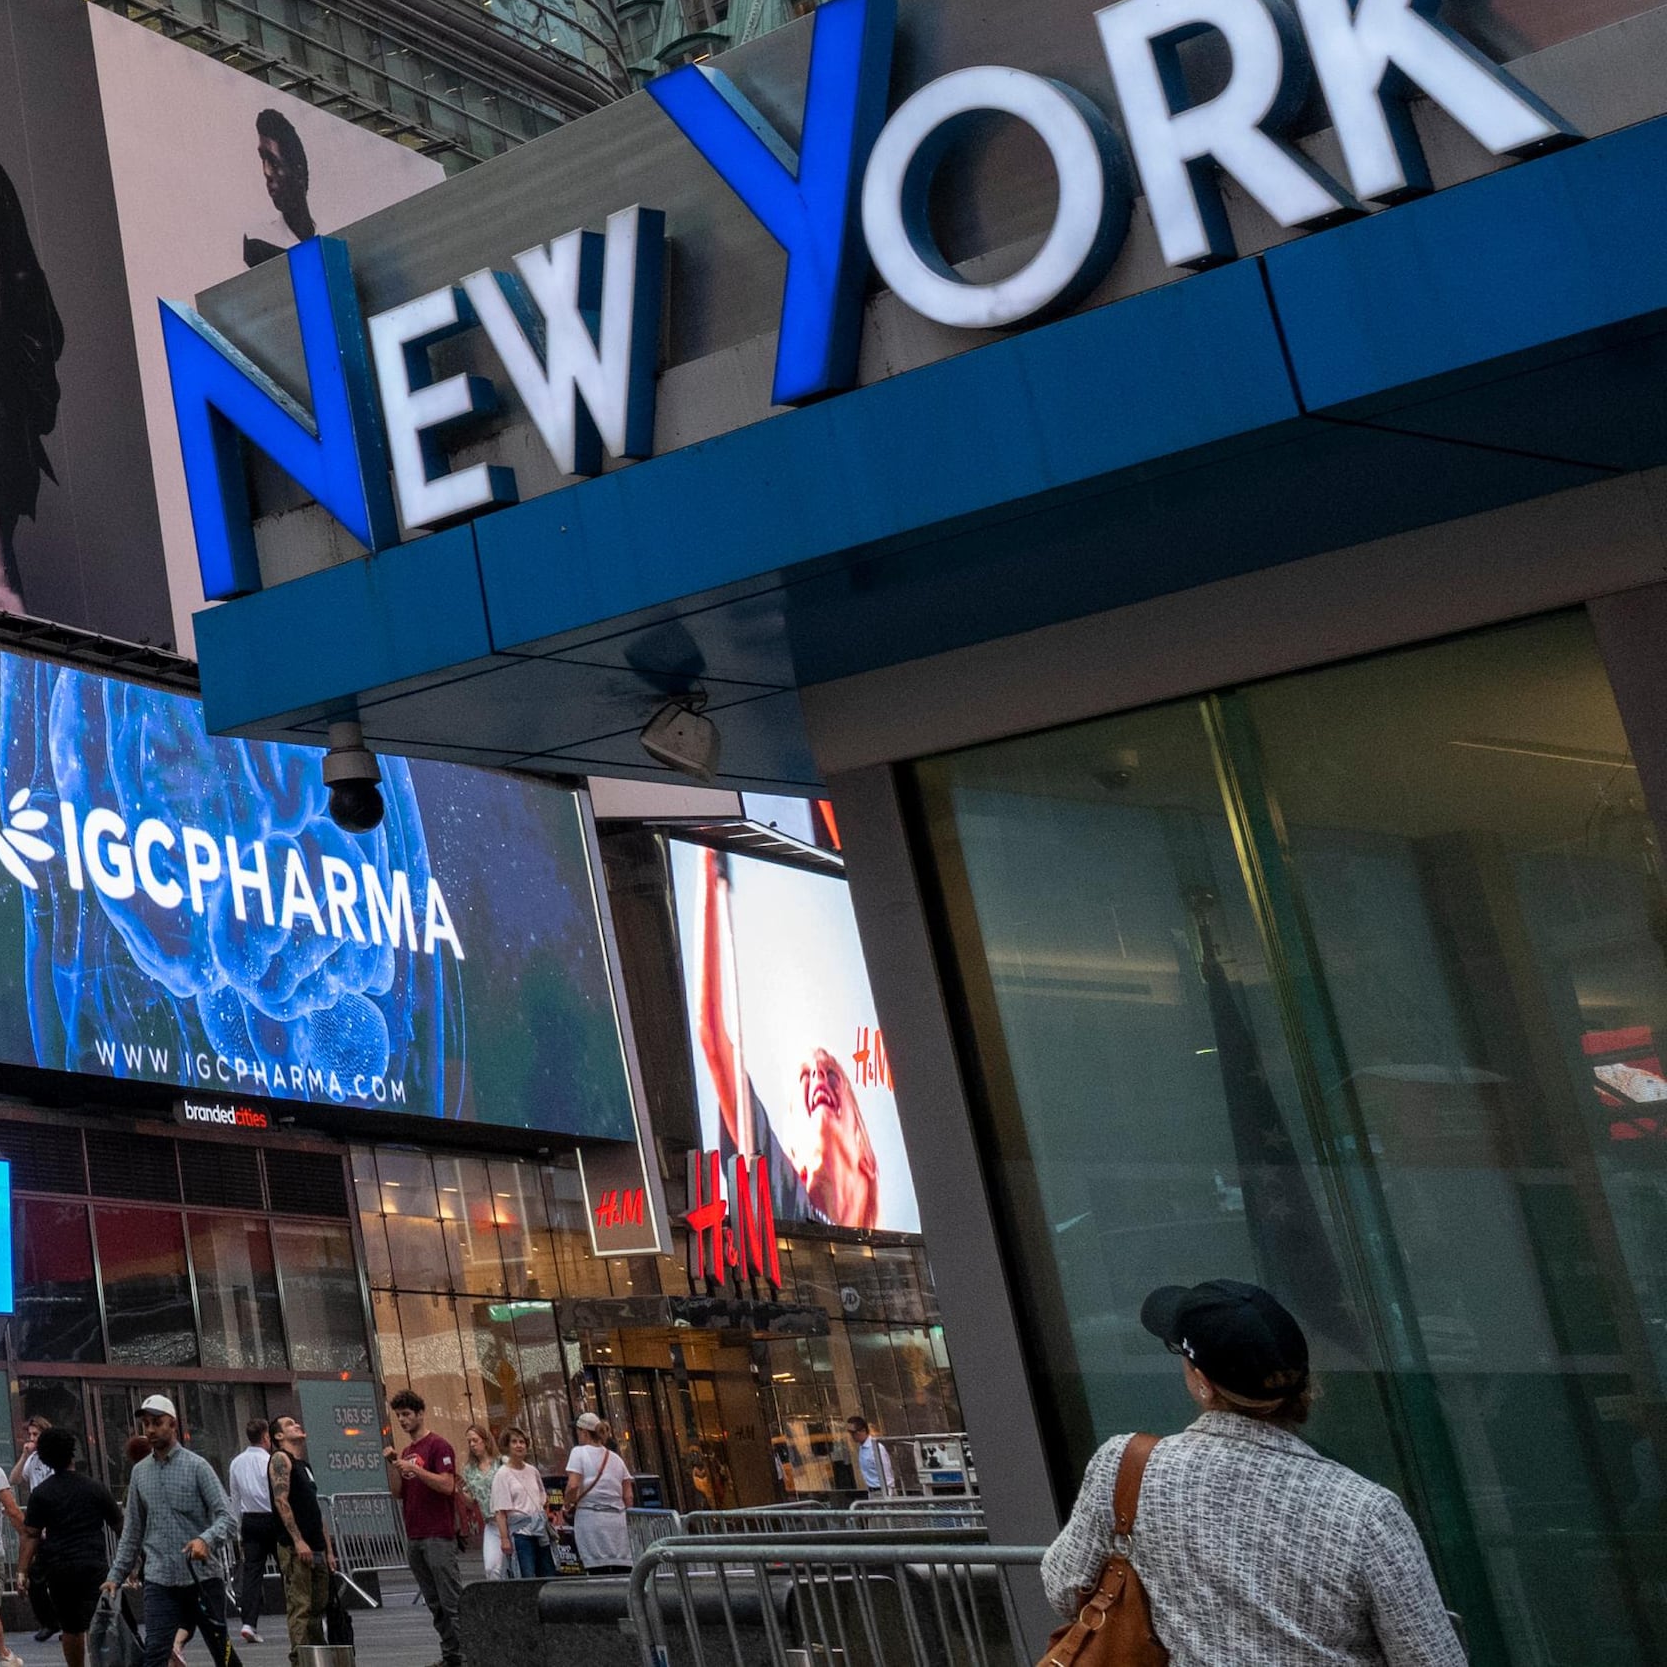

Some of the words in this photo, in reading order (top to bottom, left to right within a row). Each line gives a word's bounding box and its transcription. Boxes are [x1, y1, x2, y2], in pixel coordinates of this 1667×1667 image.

[161, 204, 664, 602] NEW
[59, 801, 466, 962] IGCPHARMA
[94, 1039, 408, 1105] WWW.IGCPHARMA.COM
[184, 1100, 267, 1130] brandedcities
[595, 1189, 644, 1227] H&M
[677, 1149, 782, 1289] H&M
[334, 1408, 360, 1426] 3,163
[361, 1408, 373, 1424] SF
[329, 1453, 365, 1471] 25,046
[367, 1453, 380, 1469] SF
